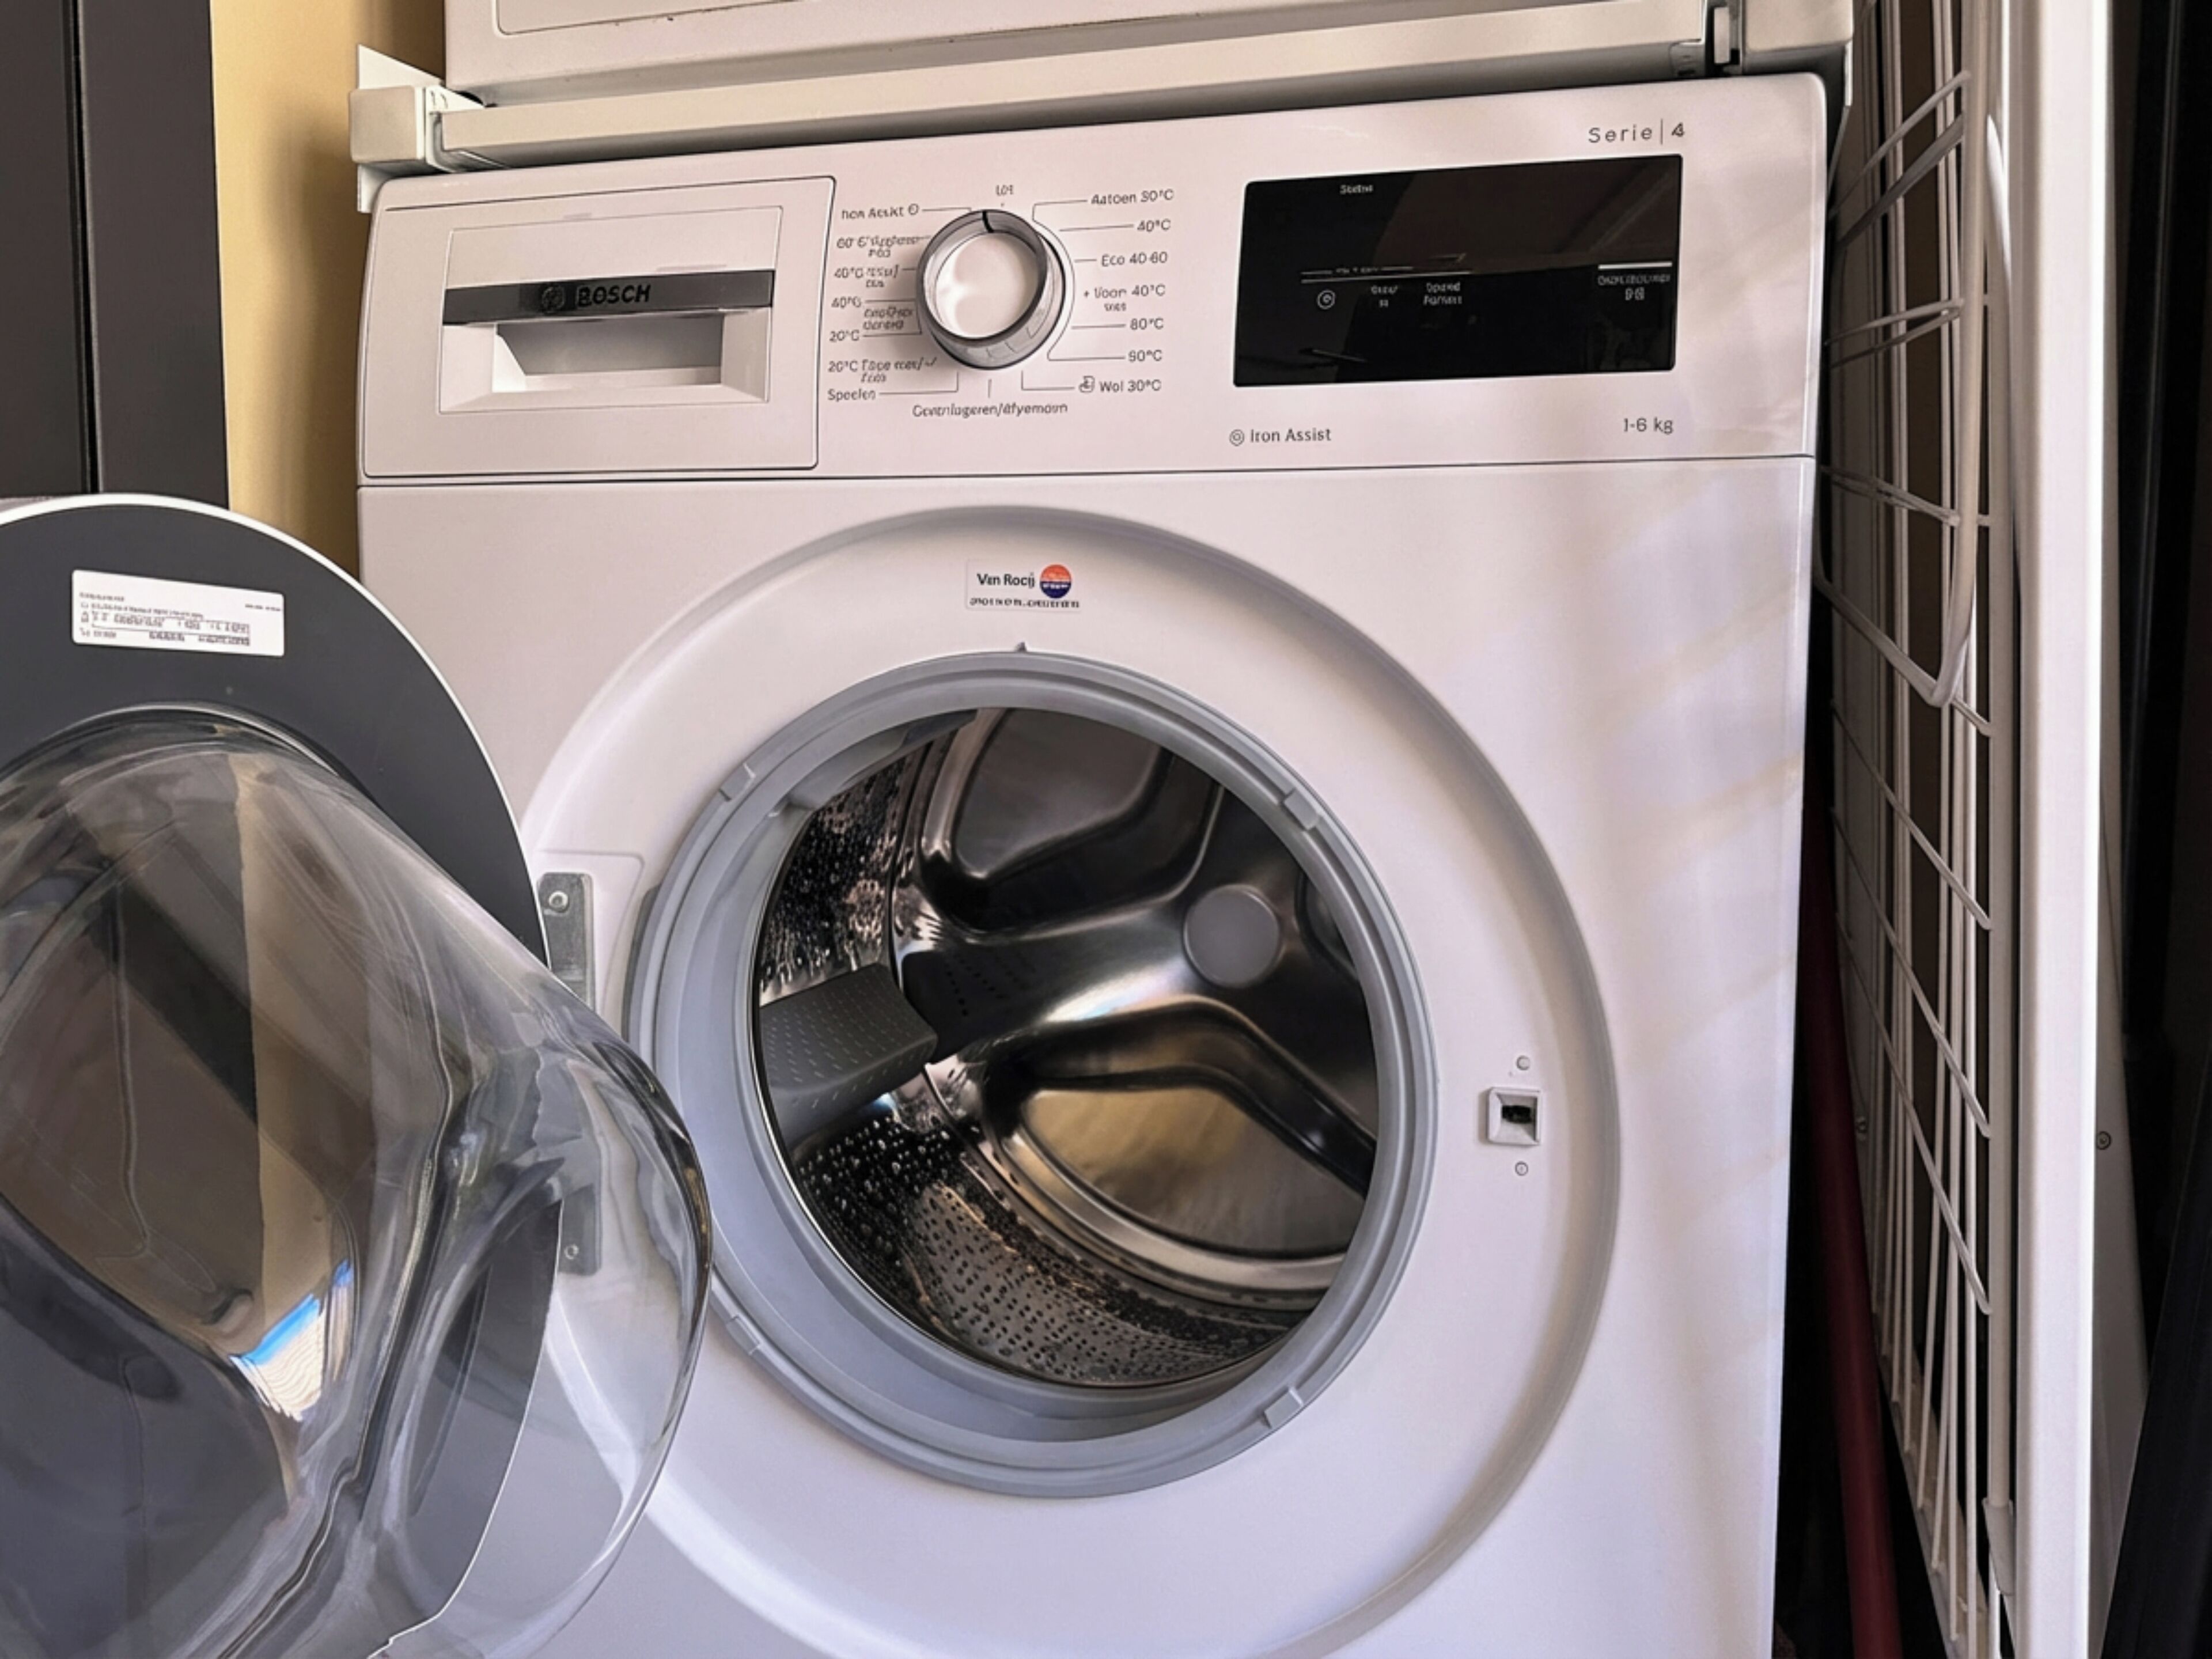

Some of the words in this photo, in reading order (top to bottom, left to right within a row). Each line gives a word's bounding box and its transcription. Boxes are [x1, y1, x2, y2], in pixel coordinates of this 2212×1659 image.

[1588, 123, 1653, 143] Serie
[1101, 253, 1125, 267] Eco
[578, 285, 652, 308] BOSCH
[1099, 380, 1123, 392] Wol
[1624, 418, 1647, 432] 1-6
[1251, 429, 1280, 442] Iron
[1285, 427, 1331, 442] Assist
